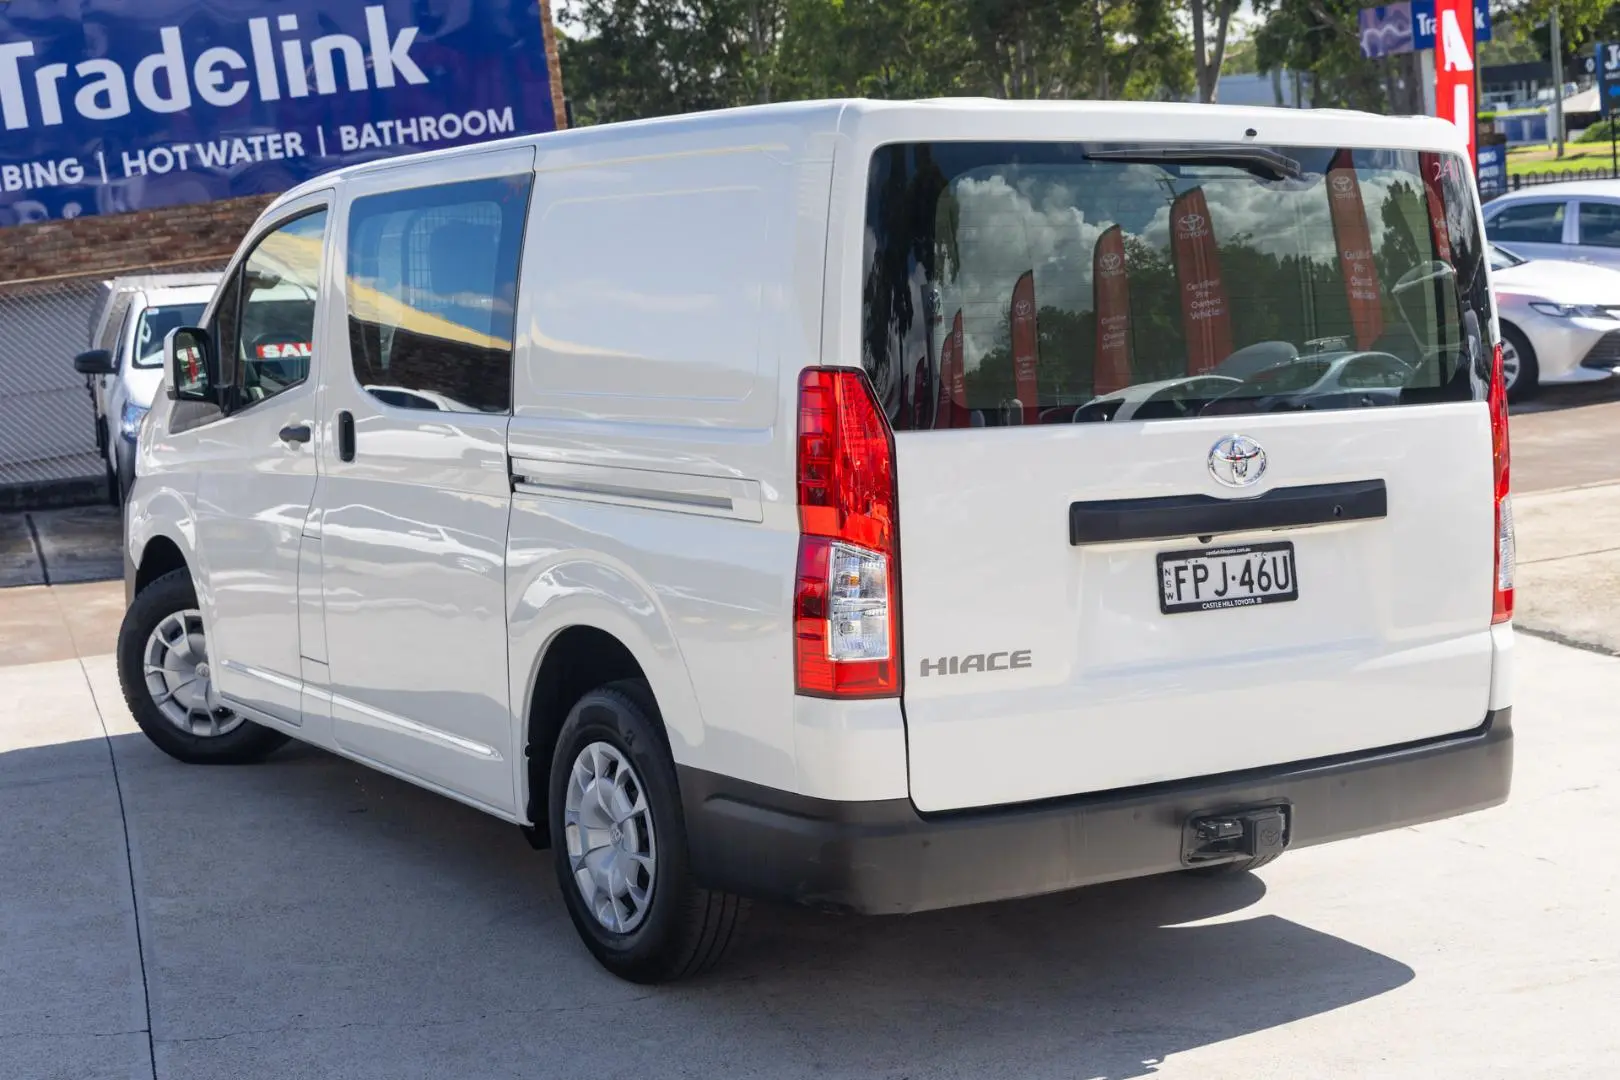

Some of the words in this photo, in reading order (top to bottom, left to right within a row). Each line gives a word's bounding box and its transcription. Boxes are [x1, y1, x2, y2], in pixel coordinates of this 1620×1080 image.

[0, 5, 430, 131] Tradelink
[0, 157, 84, 192] BING
[121, 143, 199, 178] HOT
[195, 131, 305, 168] WATER
[340, 106, 516, 151] BATHROOM
[1202, 601, 1222, 610] CASTLE
[1234, 598, 1256, 606] TOYOTA
[920, 649, 1032, 677] HIACE
